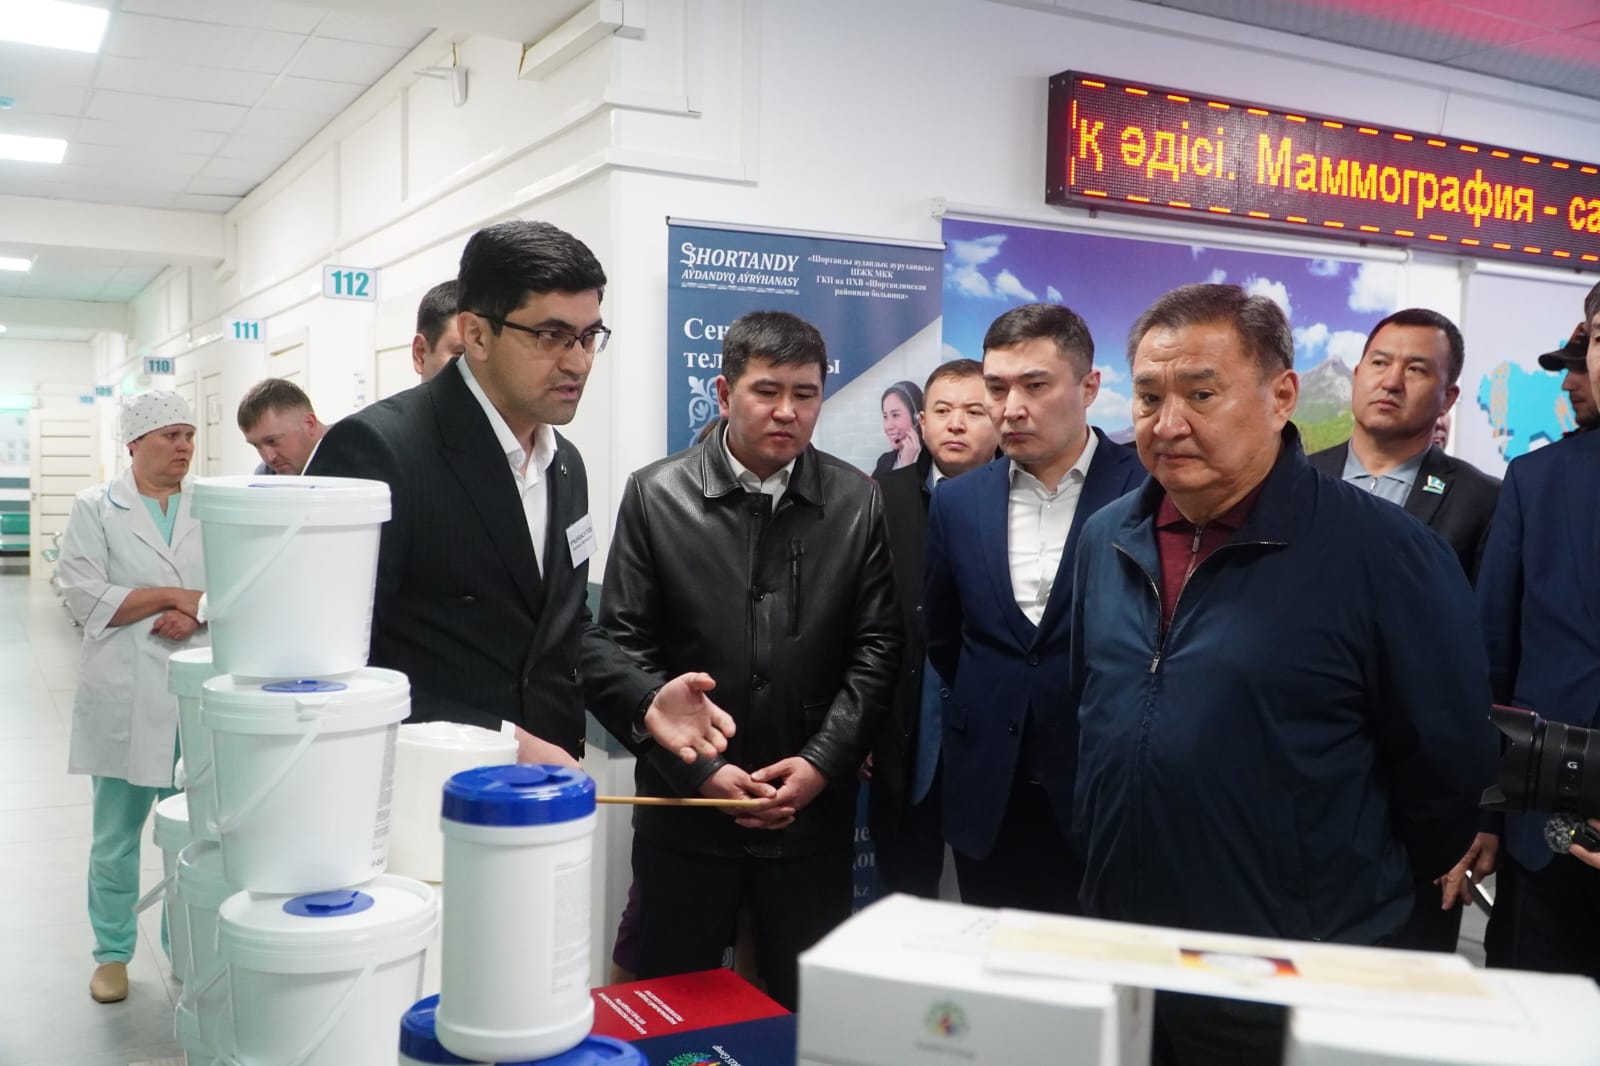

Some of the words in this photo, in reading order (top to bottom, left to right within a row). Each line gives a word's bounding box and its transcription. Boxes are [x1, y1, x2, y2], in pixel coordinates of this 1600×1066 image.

[1120, 121, 1235, 182] әдісі.
[1257, 133, 1535, 228] Маммография
[331, 270, 369, 297] 112
[232, 321, 259, 340] 111
[148, 359, 170, 373] 110
